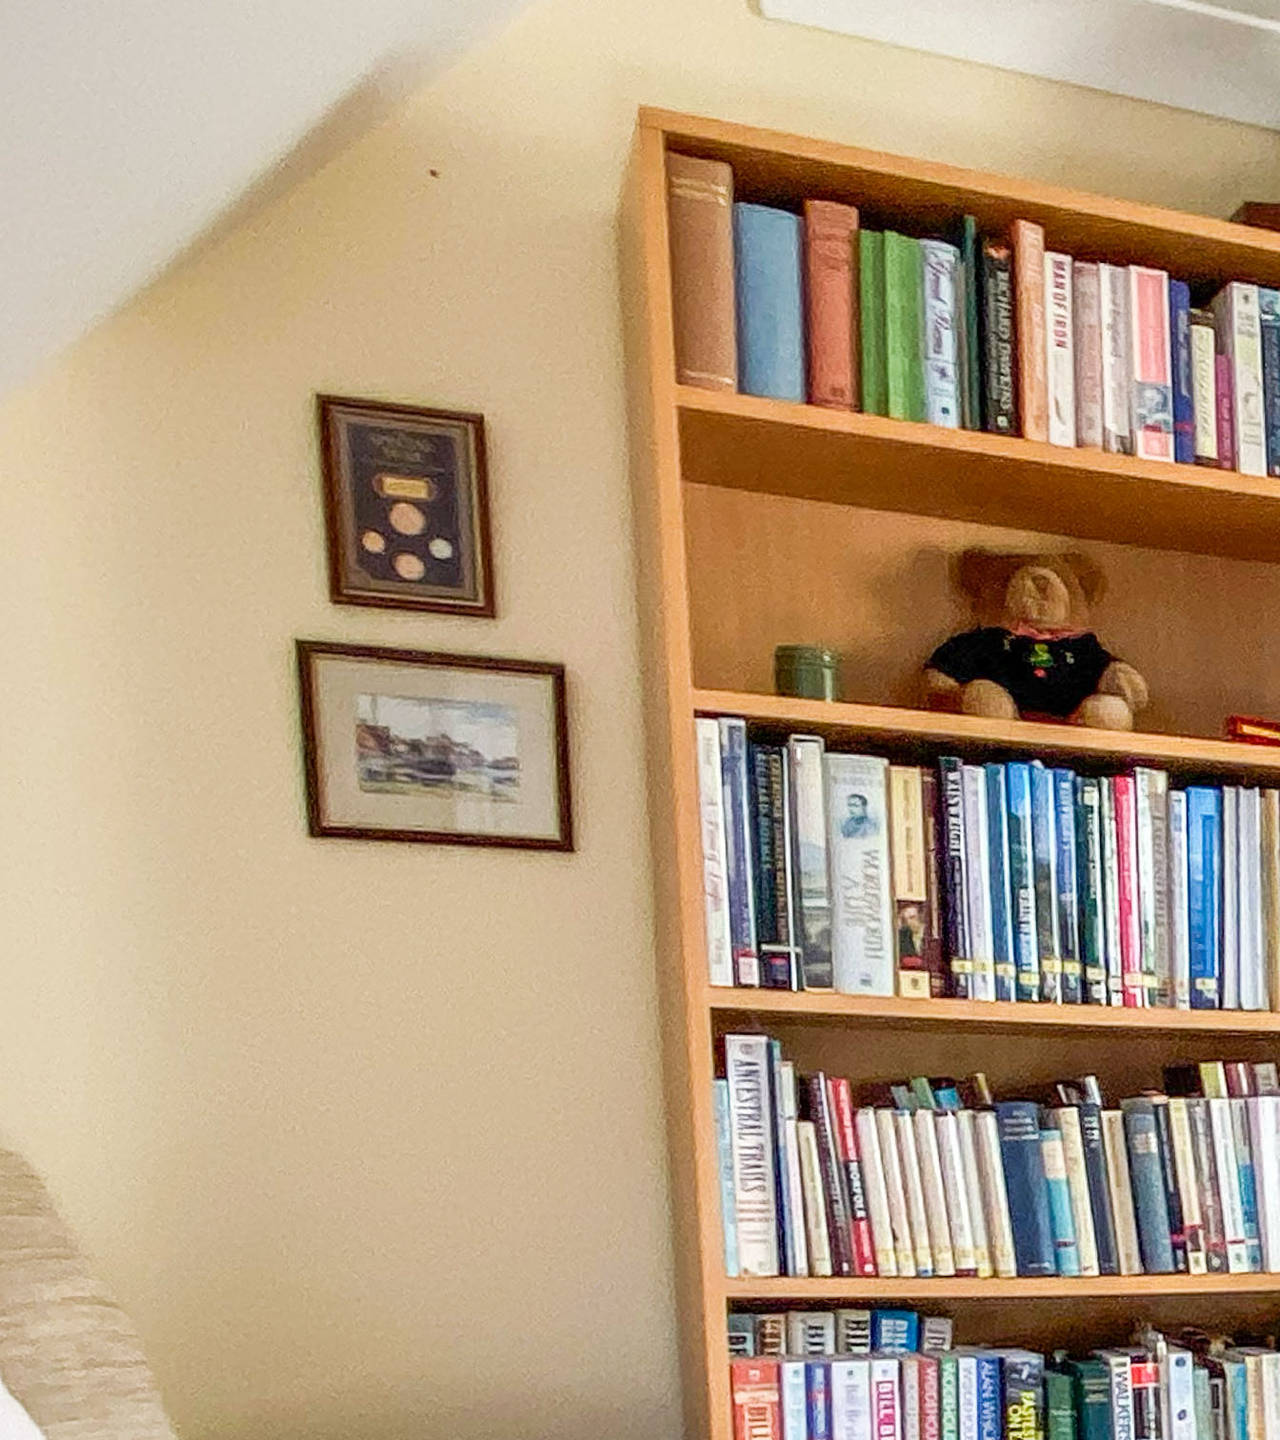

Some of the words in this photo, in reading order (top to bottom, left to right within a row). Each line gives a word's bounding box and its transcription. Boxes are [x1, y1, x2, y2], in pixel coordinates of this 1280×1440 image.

[1053, 260, 1067, 289] MAN
[1053, 291, 1068, 312] OF
[1054, 314, 1069, 350] IRON
[734, 1059, 764, 1141] ANCESTRAL
[738, 1142, 767, 1193] TRAILS
[847, 1161, 867, 1220] NORFOLK
[878, 1381, 895, 1421] BILL
[1008, 1404, 1023, 1429] ON
